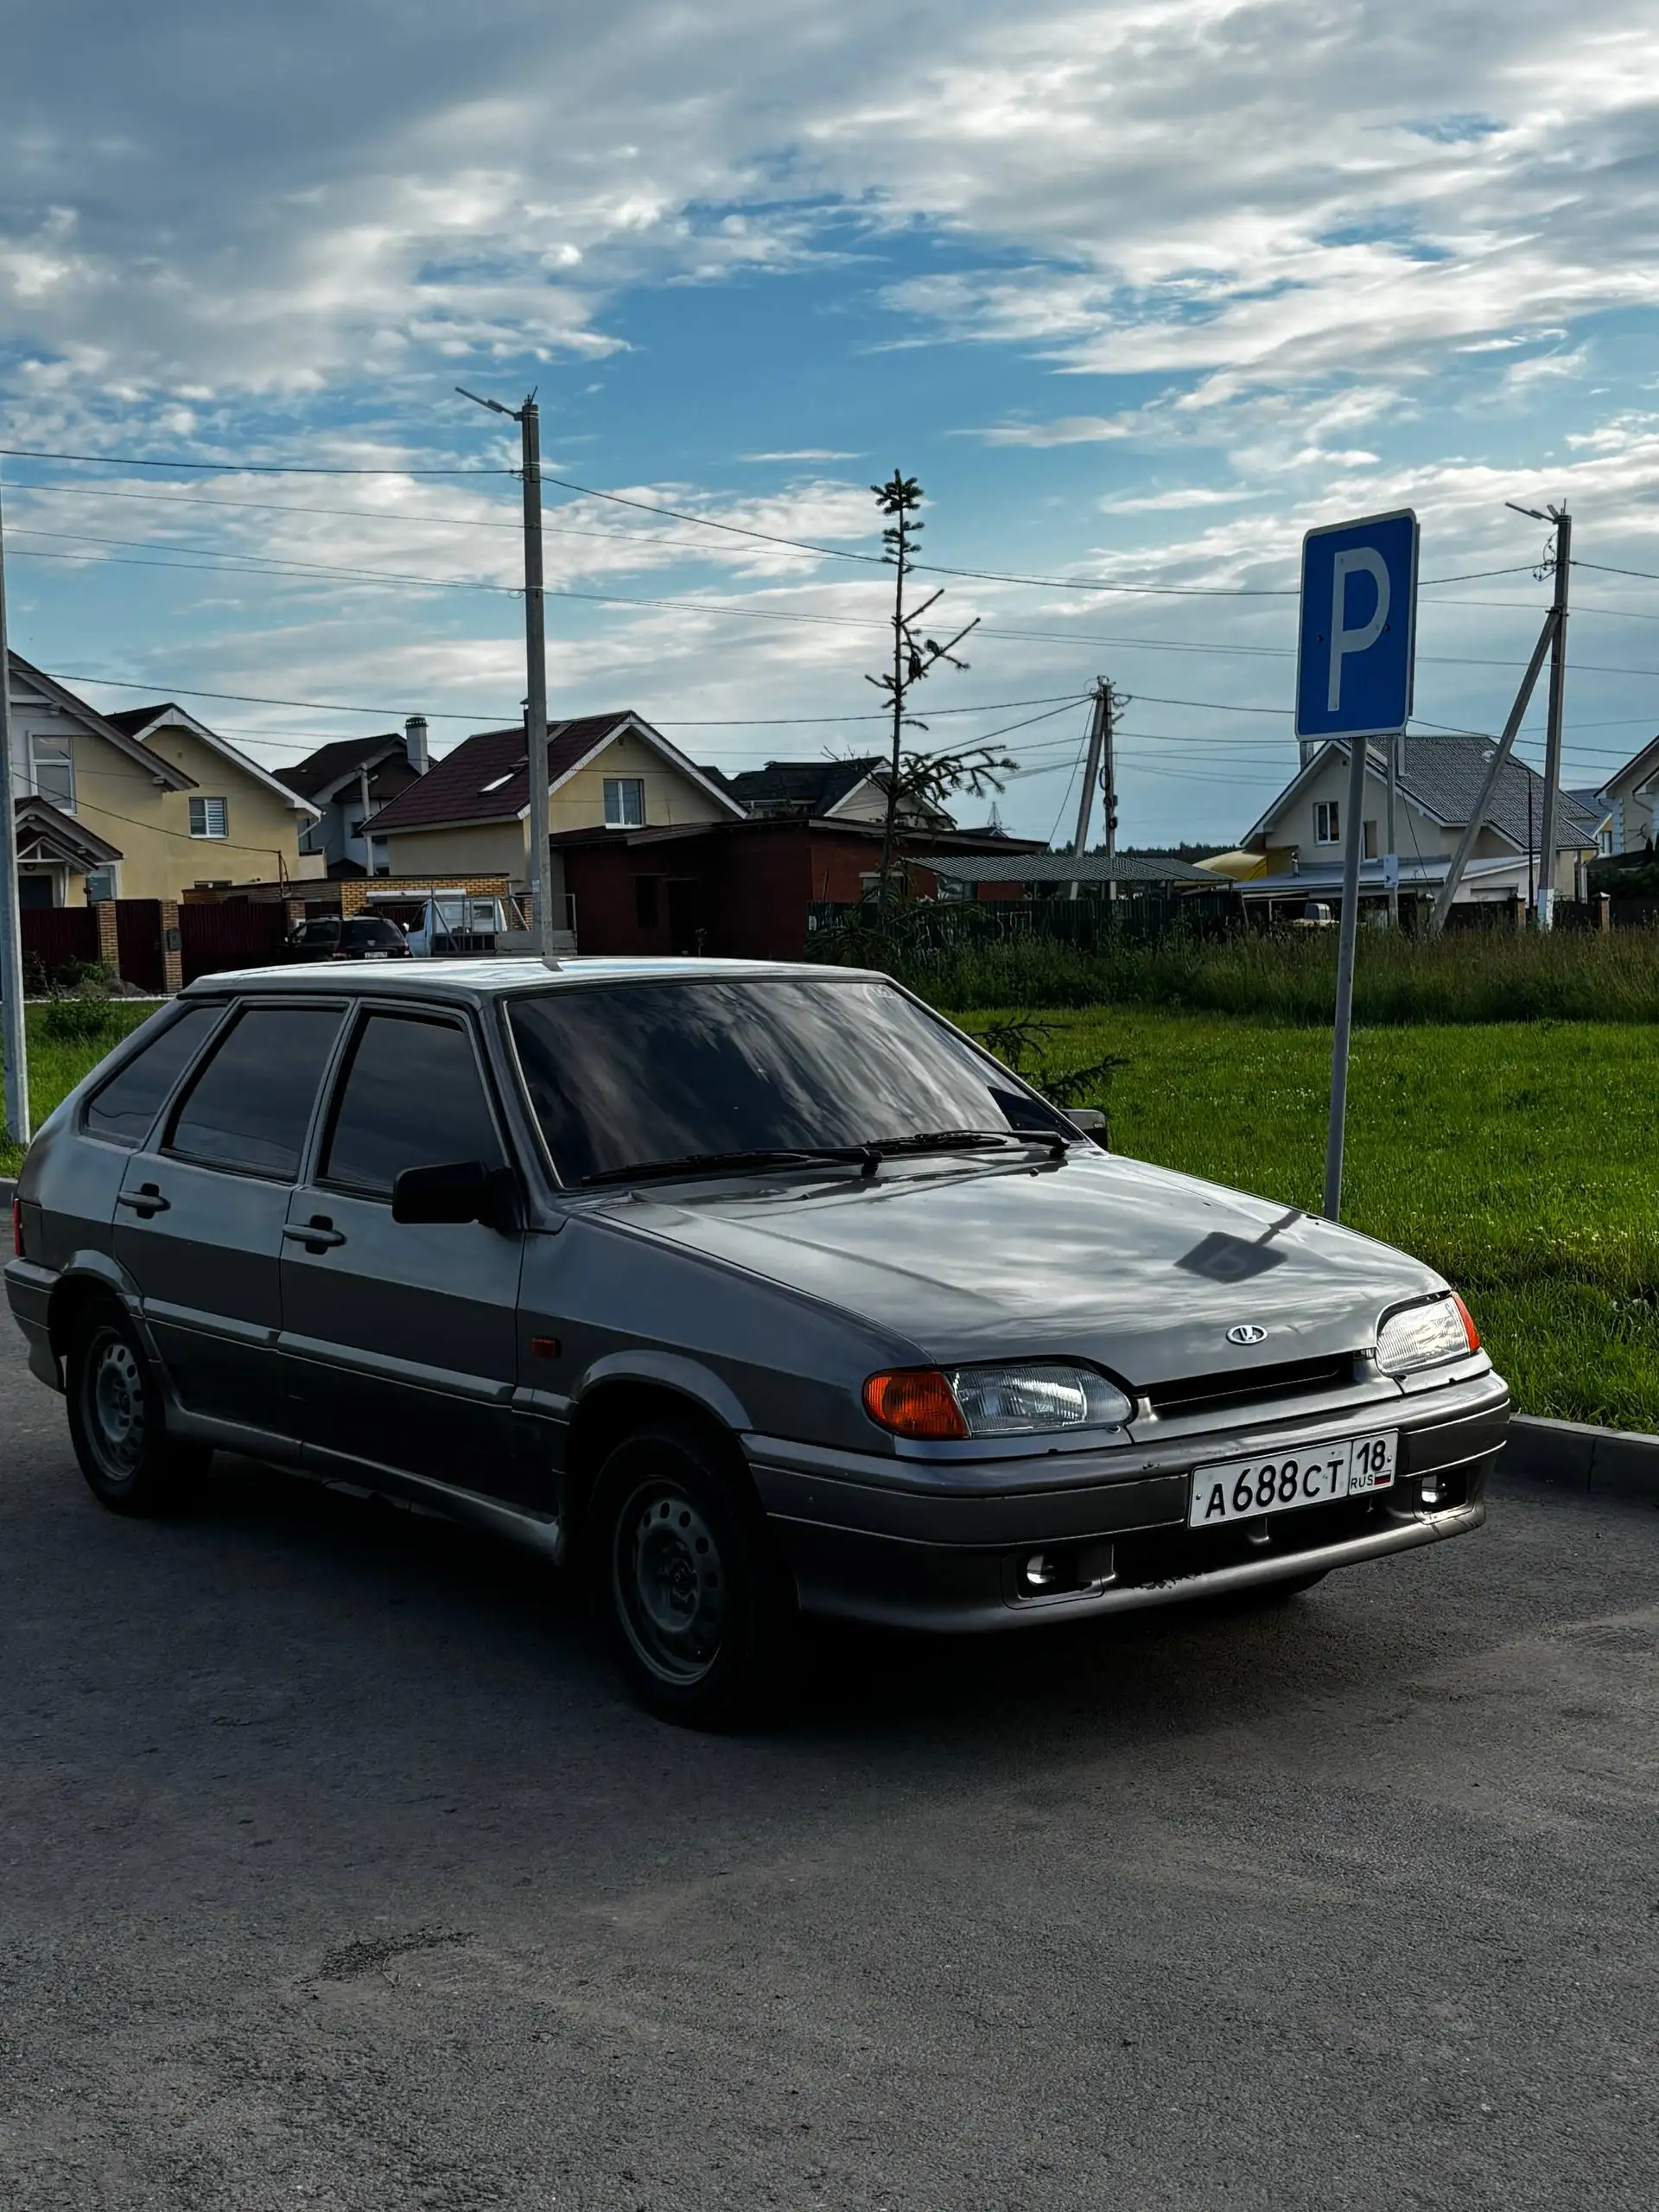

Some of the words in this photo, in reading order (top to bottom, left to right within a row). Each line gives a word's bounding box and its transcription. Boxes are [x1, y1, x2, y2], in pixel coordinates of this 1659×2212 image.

[1327, 546, 1390, 711] P
[1357, 1440, 1386, 1474] 18
[1350, 1475, 1373, 1488] RUS
